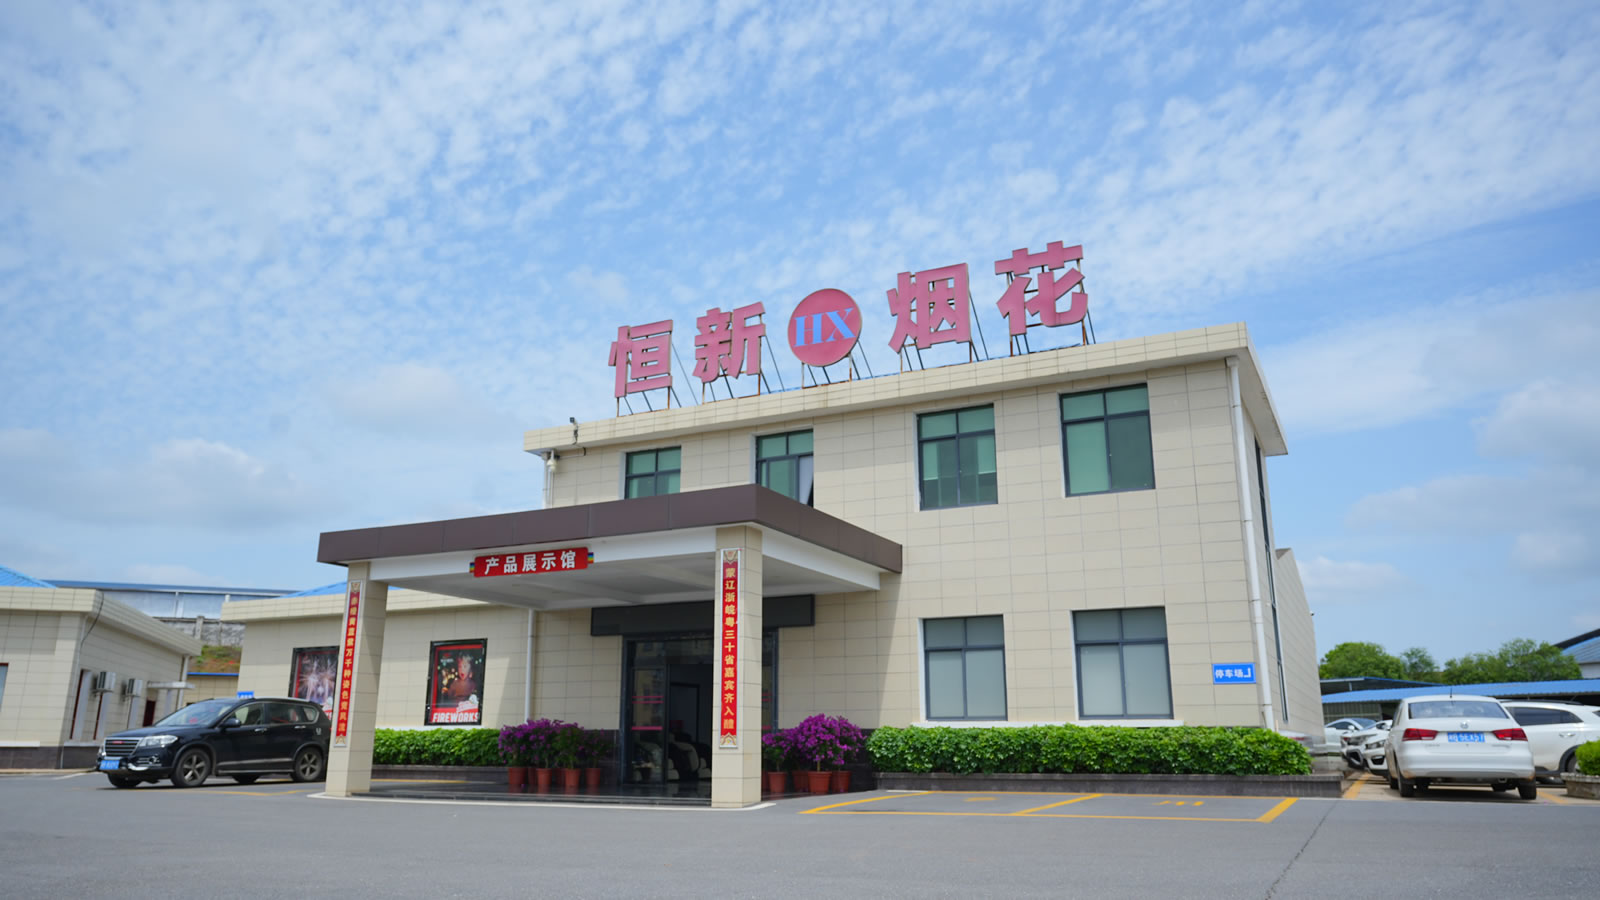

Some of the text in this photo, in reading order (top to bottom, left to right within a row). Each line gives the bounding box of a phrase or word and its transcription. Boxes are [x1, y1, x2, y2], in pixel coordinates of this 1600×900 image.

[608, 240, 1089, 398] 恒新 HX 烟花
[484, 550, 576, 575] 产品展示馆
[1215, 668, 1244, 679] 停车场
[432, 711, 480, 723] FIREWORKS
